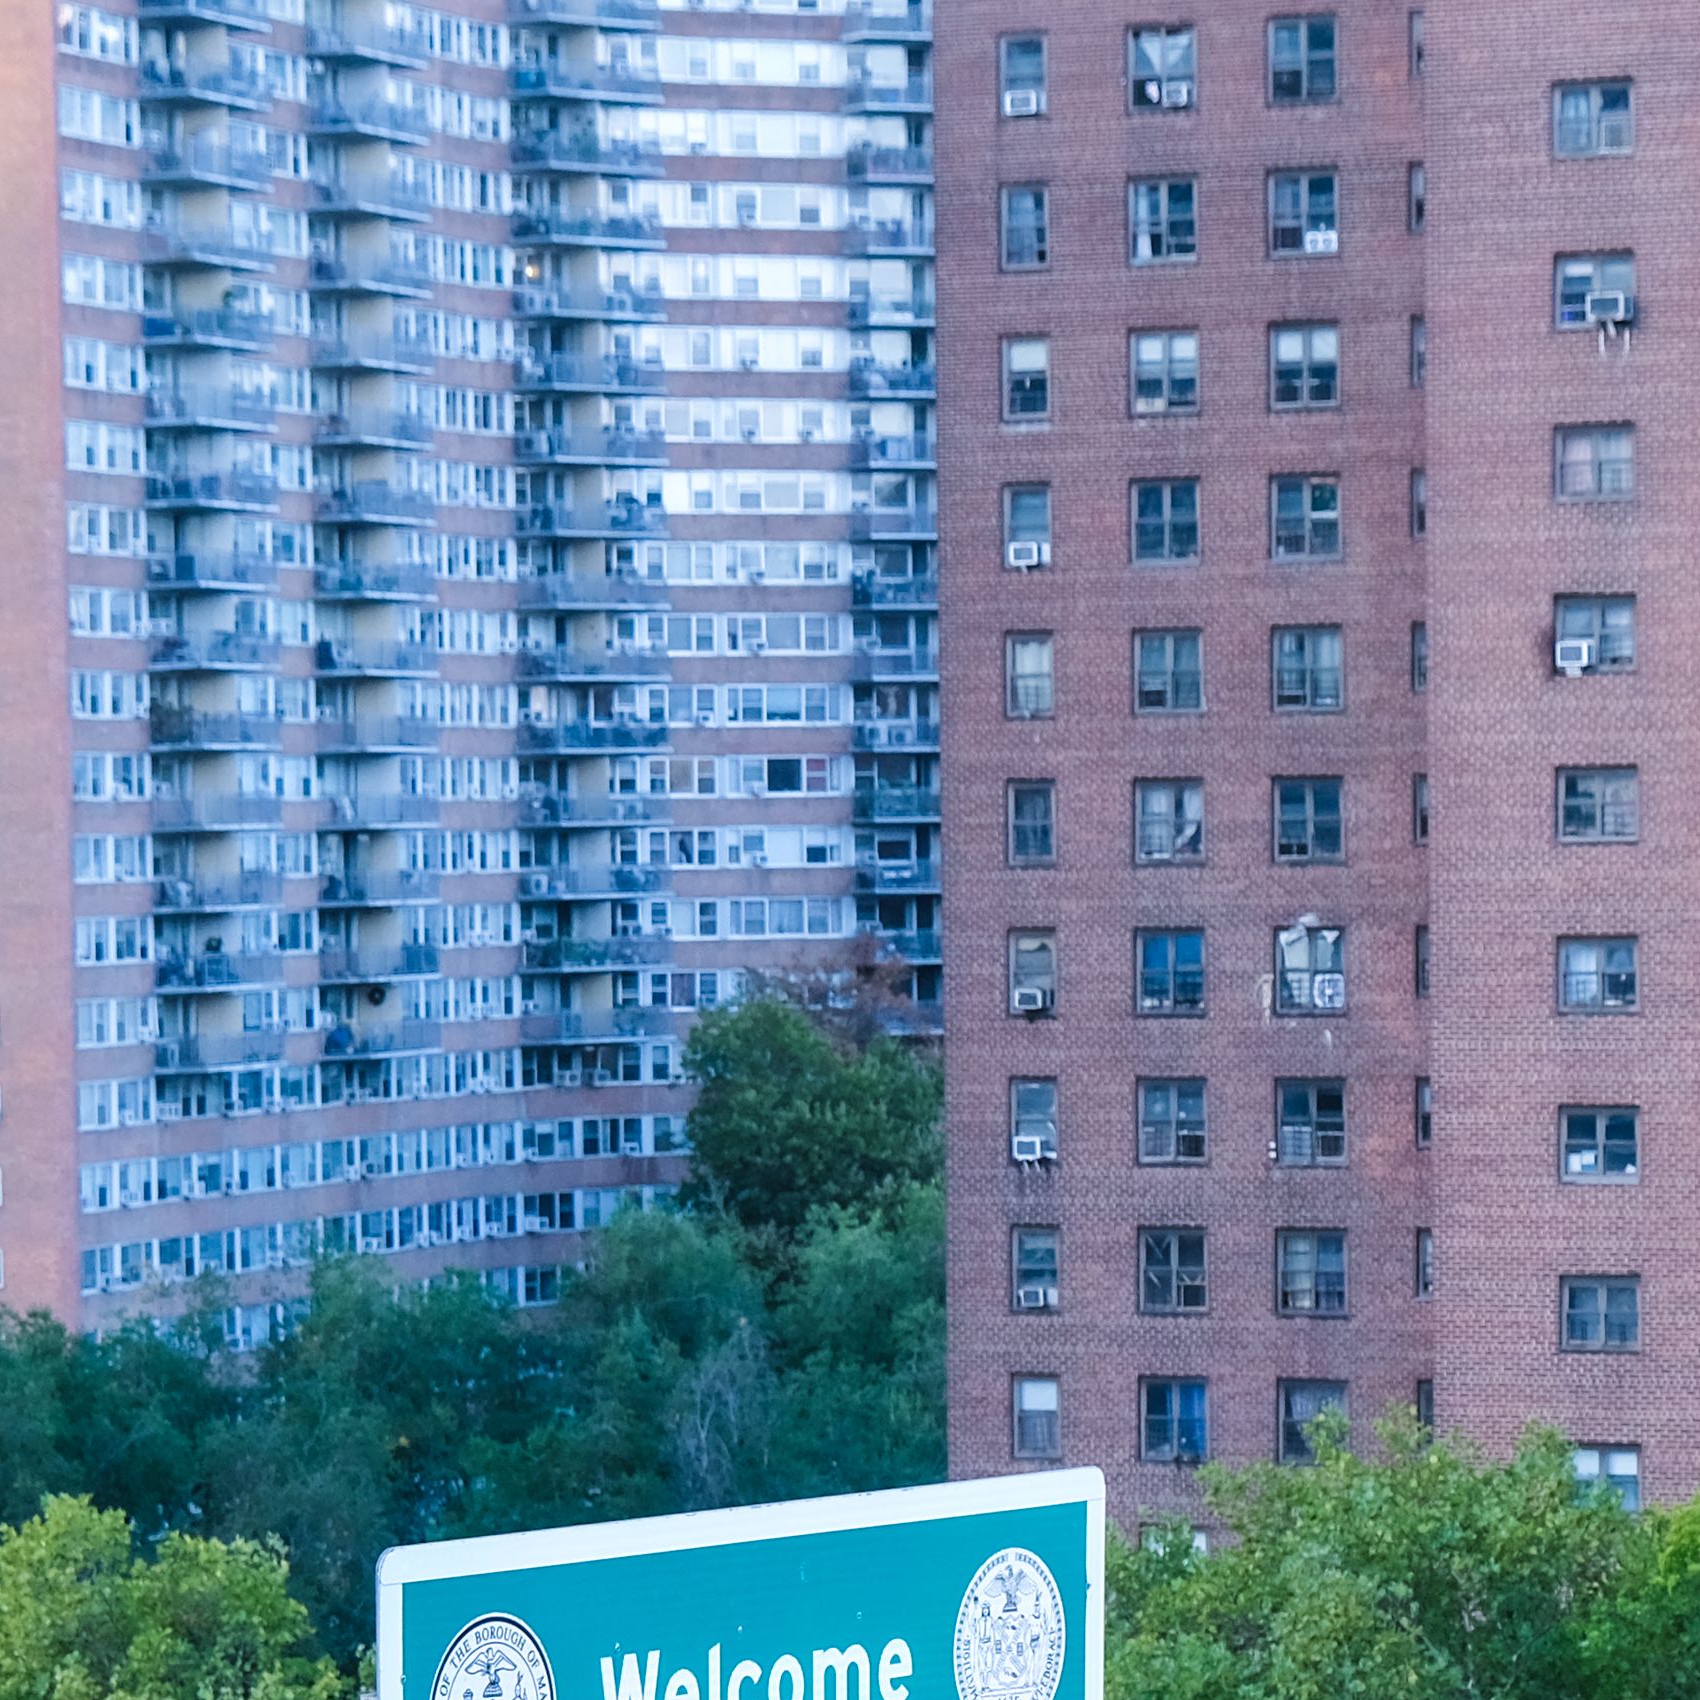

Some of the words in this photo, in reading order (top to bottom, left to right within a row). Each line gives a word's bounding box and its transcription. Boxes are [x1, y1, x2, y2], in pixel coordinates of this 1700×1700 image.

[440, 1675, 451, 1696] OF
[450, 1640, 471, 1669] THE
[474, 1625, 527, 1651] BOROUGH
[528, 1651, 540, 1668] OF
